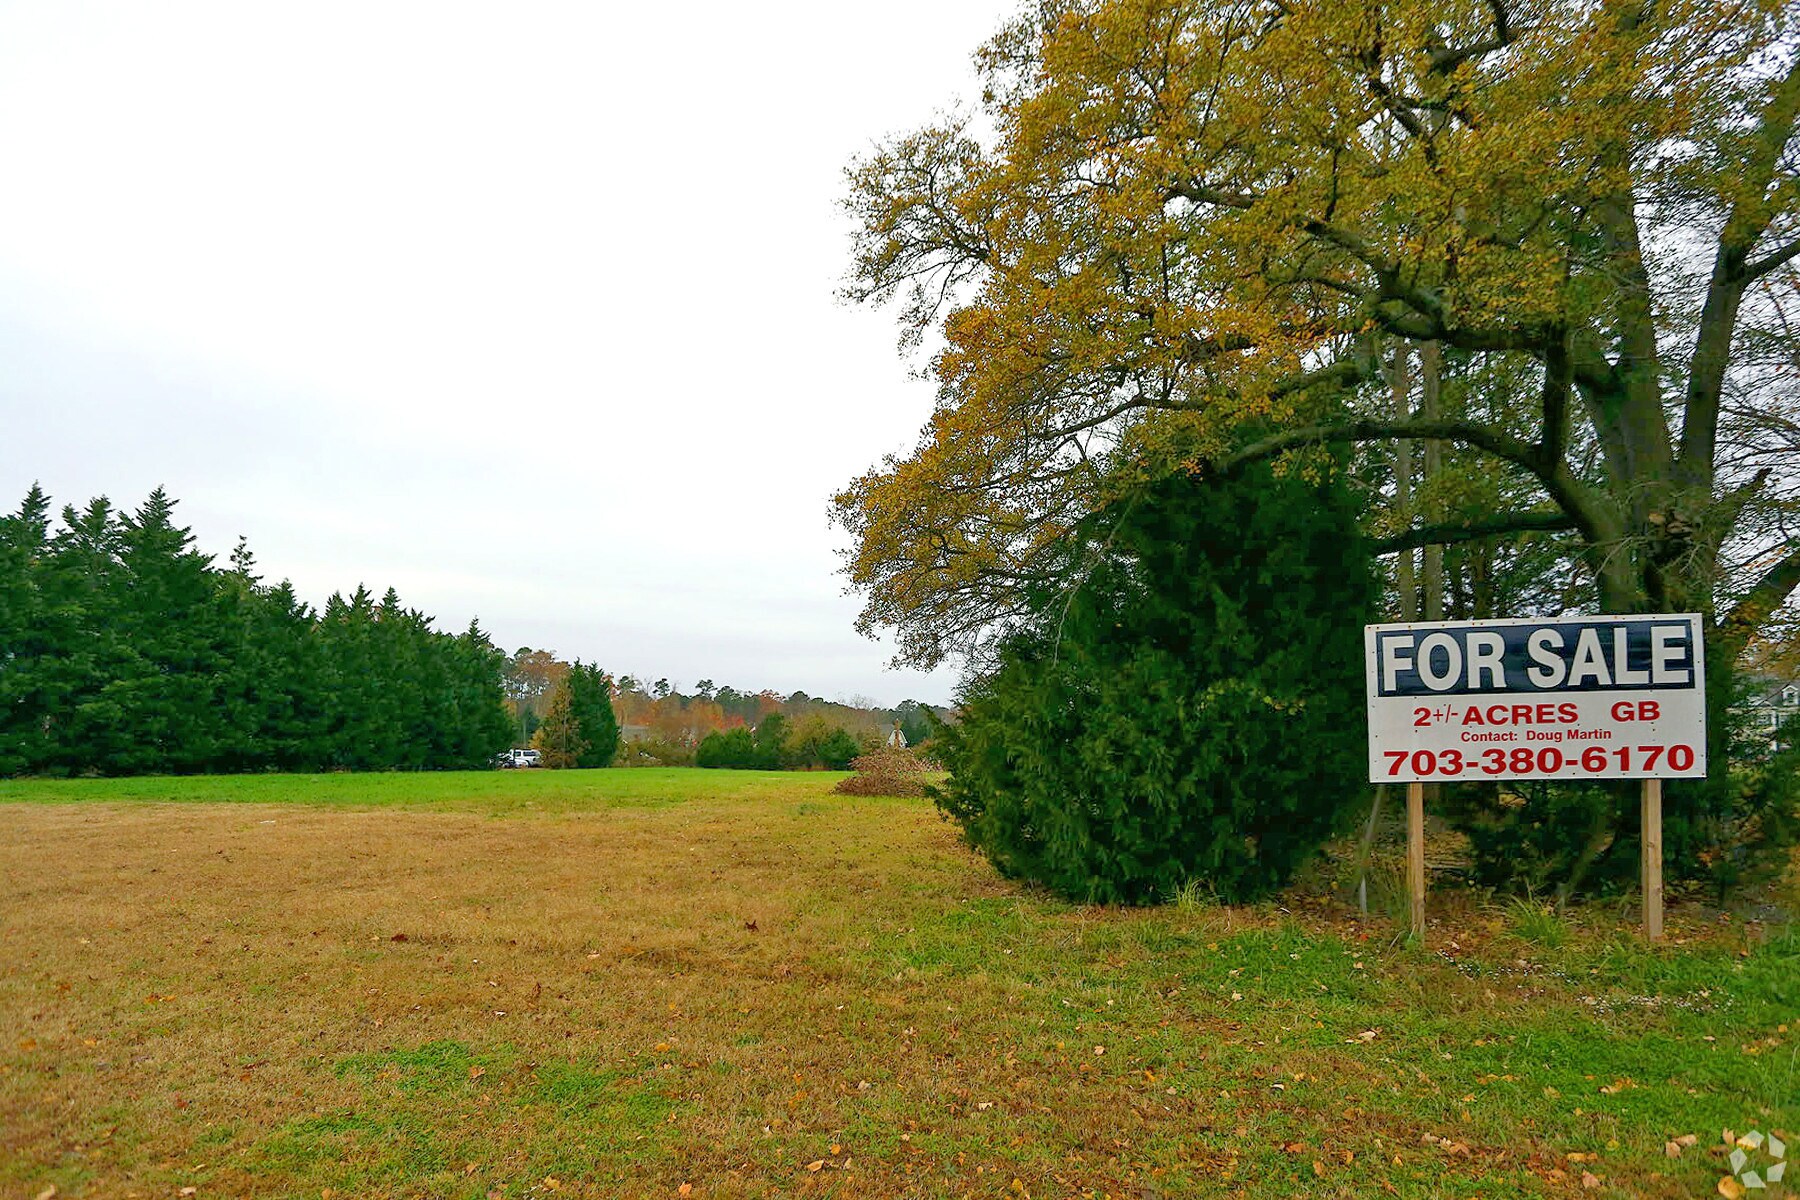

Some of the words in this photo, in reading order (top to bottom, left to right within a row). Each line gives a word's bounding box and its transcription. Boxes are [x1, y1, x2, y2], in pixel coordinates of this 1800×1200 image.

[1381, 630, 1507, 692] FOR
[1527, 625, 1690, 688] SALE
[1610, 700, 1661, 722] GB
[1461, 730, 1518, 742] Contact:
[1526, 730, 1563, 743] Doug
[1567, 729, 1612, 741] Martin
[1383, 744, 1695, 776] 703-380-6170
